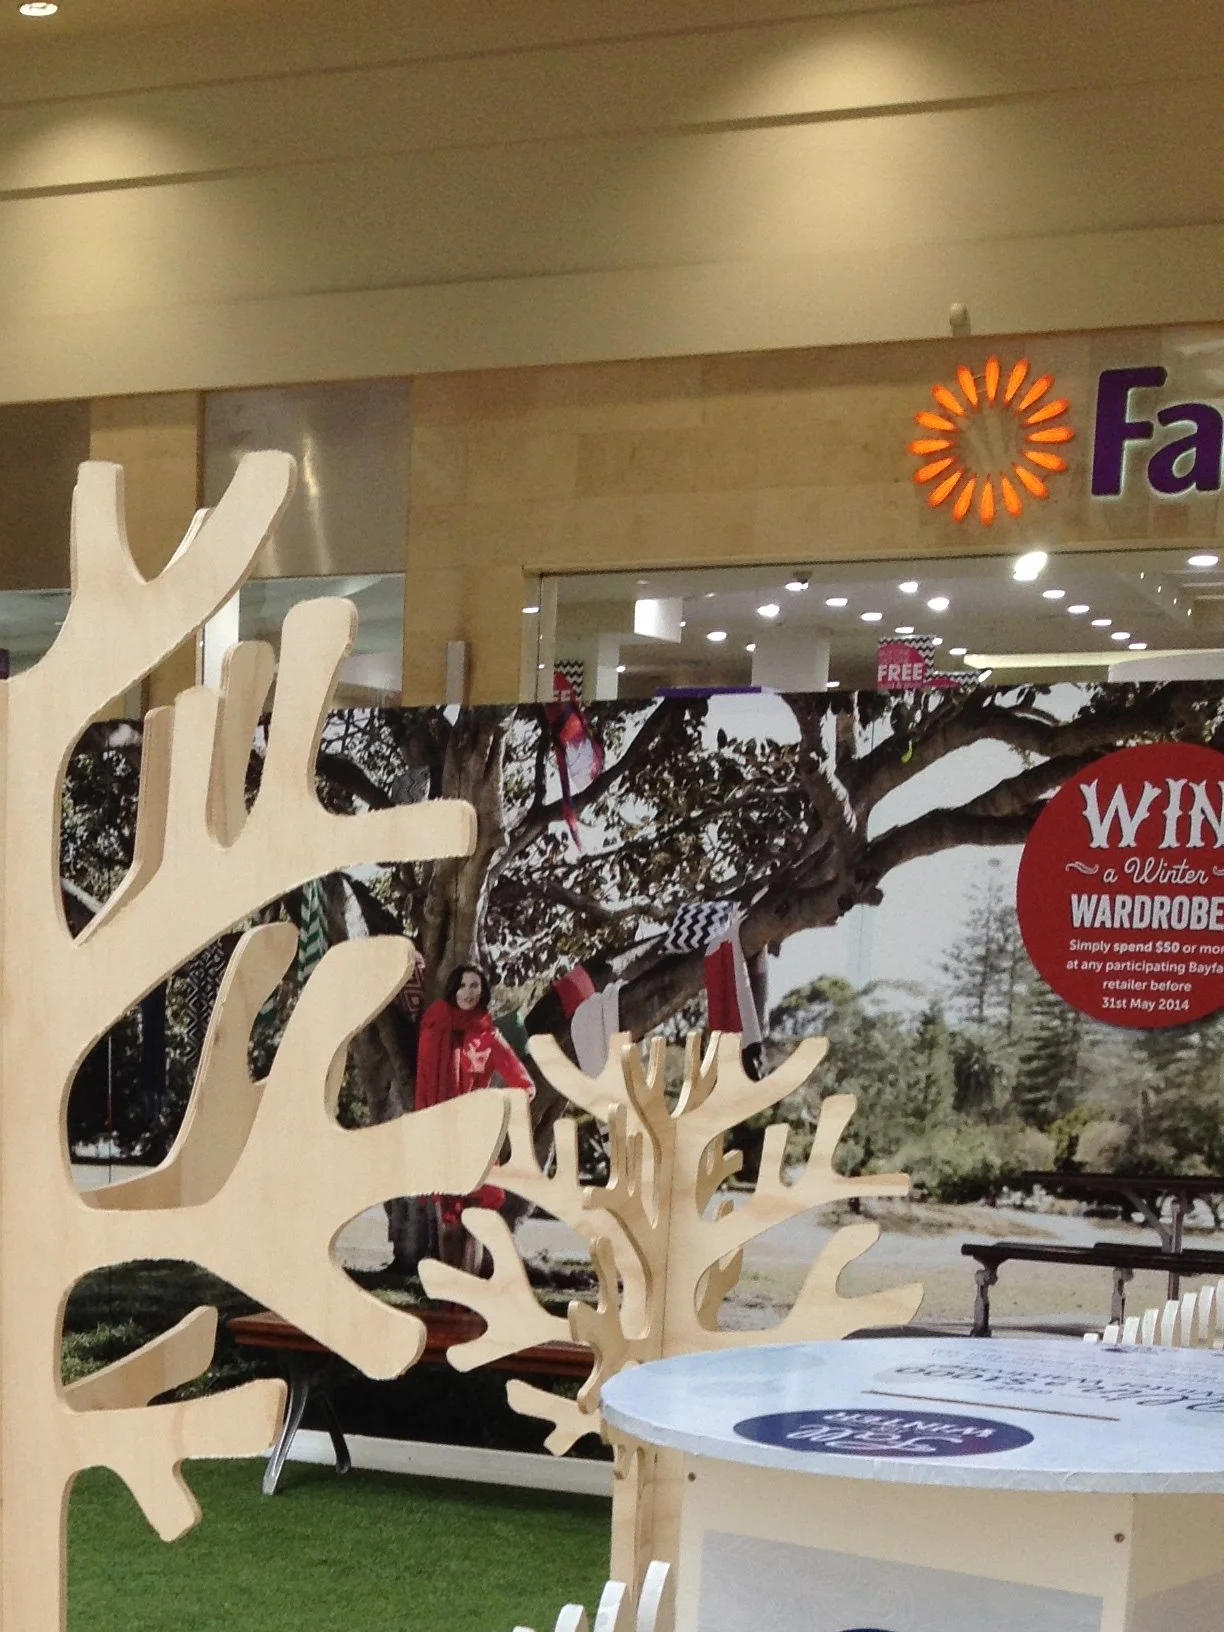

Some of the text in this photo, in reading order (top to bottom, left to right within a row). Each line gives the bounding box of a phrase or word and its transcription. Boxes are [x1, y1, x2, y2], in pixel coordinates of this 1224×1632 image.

[1091, 366, 1224, 497] Fa
[877, 663, 924, 682] FREE
[1079, 778, 1224, 850] WIN
[1103, 857, 1209, 884] a Winter
[1071, 892, 1224, 932] WARDROBE
[1069, 938, 1111, 954] Simply
[1113, 941, 1153, 955] spend
[1155, 939, 1181, 954] $50
[1182, 943, 1197, 954] or
[1066, 959, 1079, 971] at
[1080, 960, 1104, 973] any
[1105, 959, 1187, 975] participating
[1102, 979, 1193, 993] retailer before
[1101, 996, 1191, 1012] 31st May 2014
[785, 1423, 963, 1453] Fall
[822, 1411, 997, 1438] WINTER
